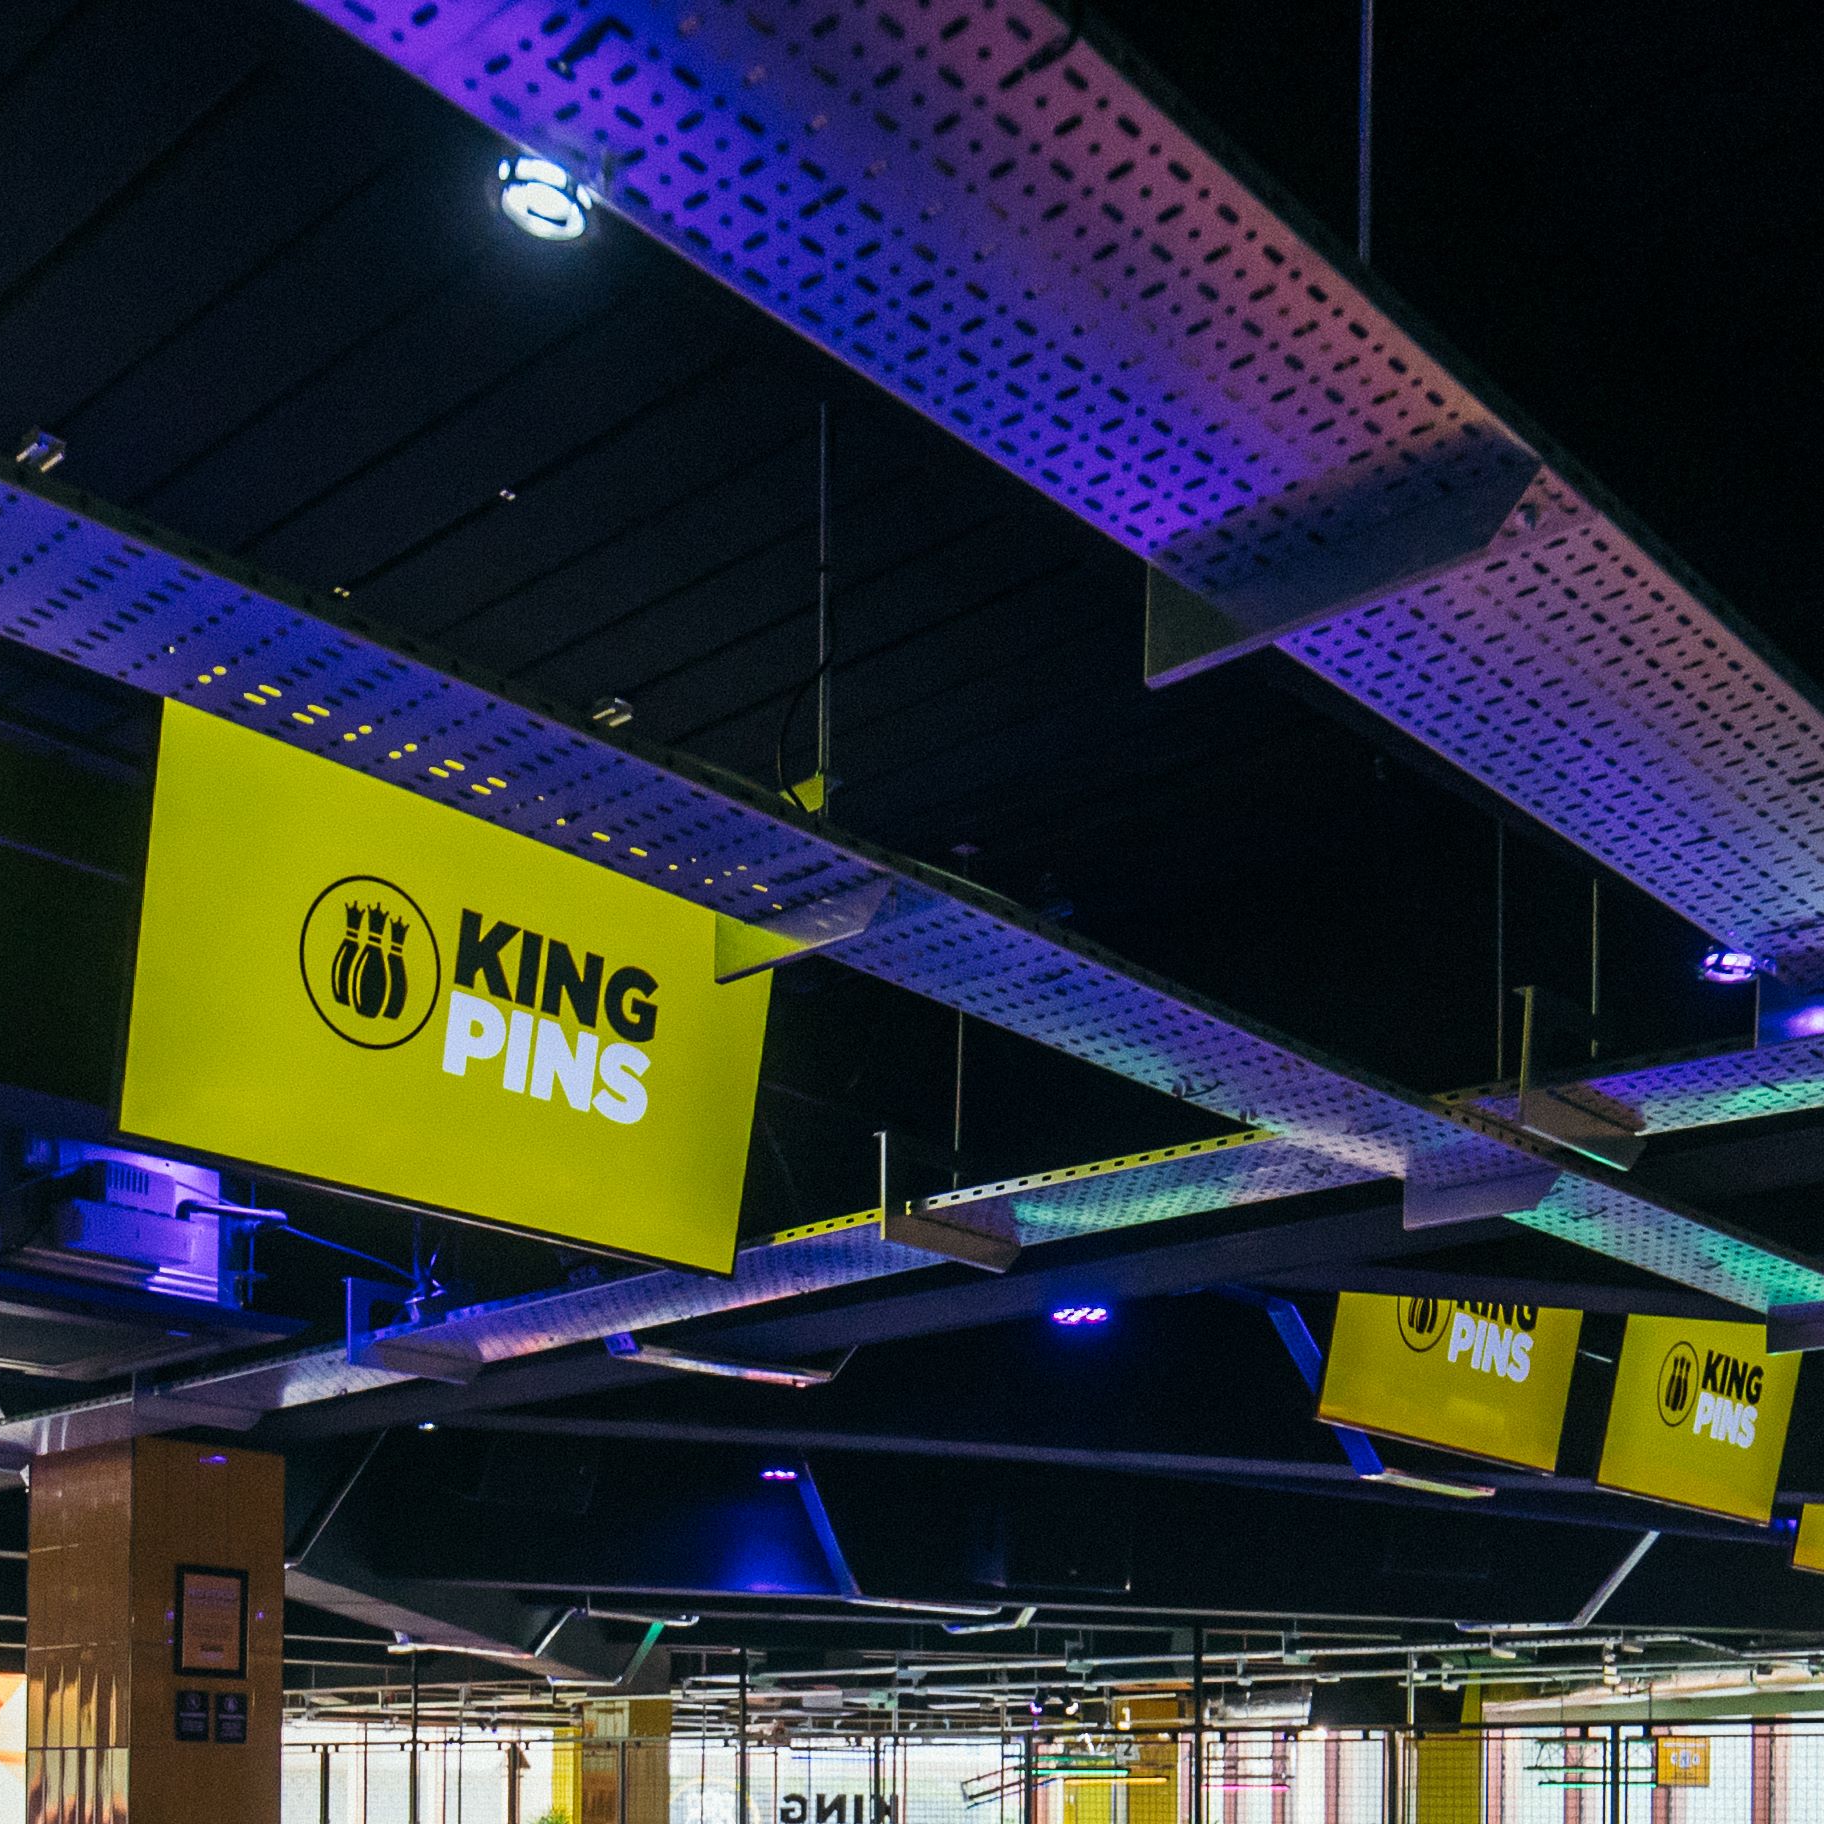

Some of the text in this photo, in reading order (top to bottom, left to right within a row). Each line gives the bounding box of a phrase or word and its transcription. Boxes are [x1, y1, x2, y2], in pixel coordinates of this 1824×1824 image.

[454, 907, 659, 1042] KING
[442, 990, 651, 1124] PINS
[1447, 1311, 1534, 1382] PINS
[1701, 1349, 1764, 1404] KING
[1693, 1392, 1758, 1448] PINS
